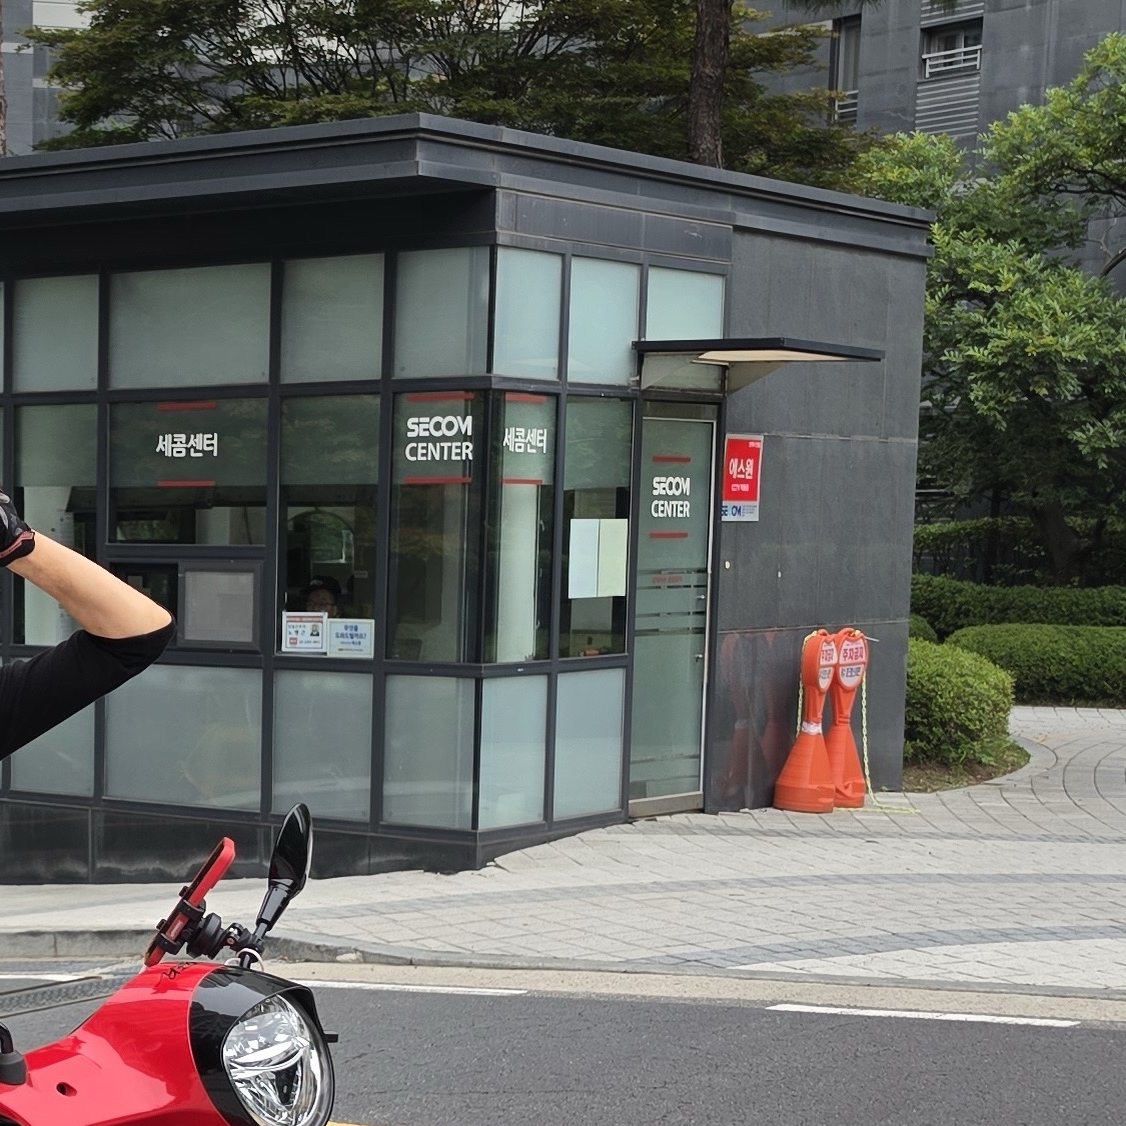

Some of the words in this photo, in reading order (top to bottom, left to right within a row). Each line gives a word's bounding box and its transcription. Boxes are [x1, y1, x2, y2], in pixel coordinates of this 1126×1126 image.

[407, 416, 472, 438] SECOM
[156, 433, 218, 457] 세콤센터
[503, 427, 547, 454] 세콤센터
[405, 442, 473, 462] CENTER
[729, 457, 754, 480] 에스원
[652, 477, 691, 496] SECOM
[651, 501, 690, 518] CENTER
